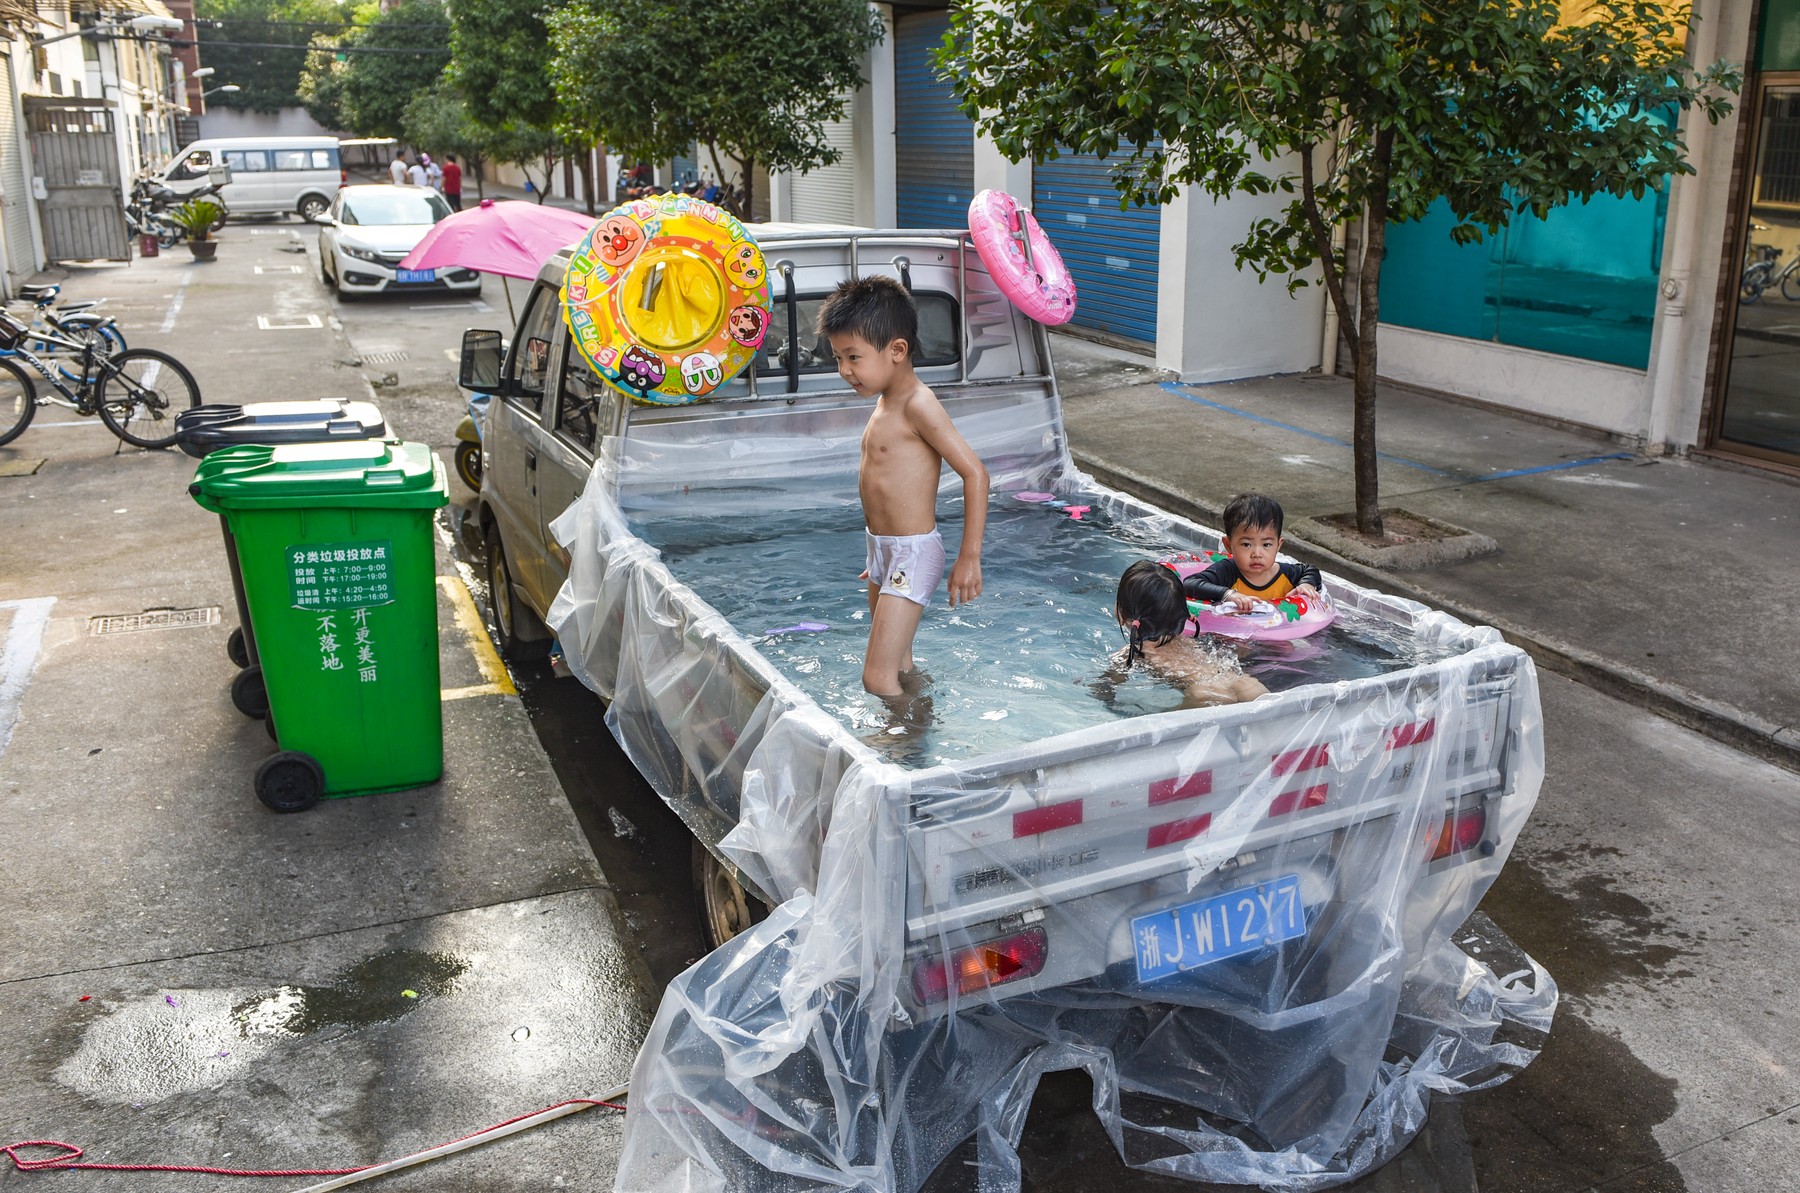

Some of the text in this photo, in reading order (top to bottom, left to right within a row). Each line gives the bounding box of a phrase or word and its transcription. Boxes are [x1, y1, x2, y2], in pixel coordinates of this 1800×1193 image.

[293, 547, 386, 564] 分类垃圾投放点
[295, 568, 315, 576] 投放
[295, 577, 316, 585] 时间
[316, 608, 344, 671] 不落地
